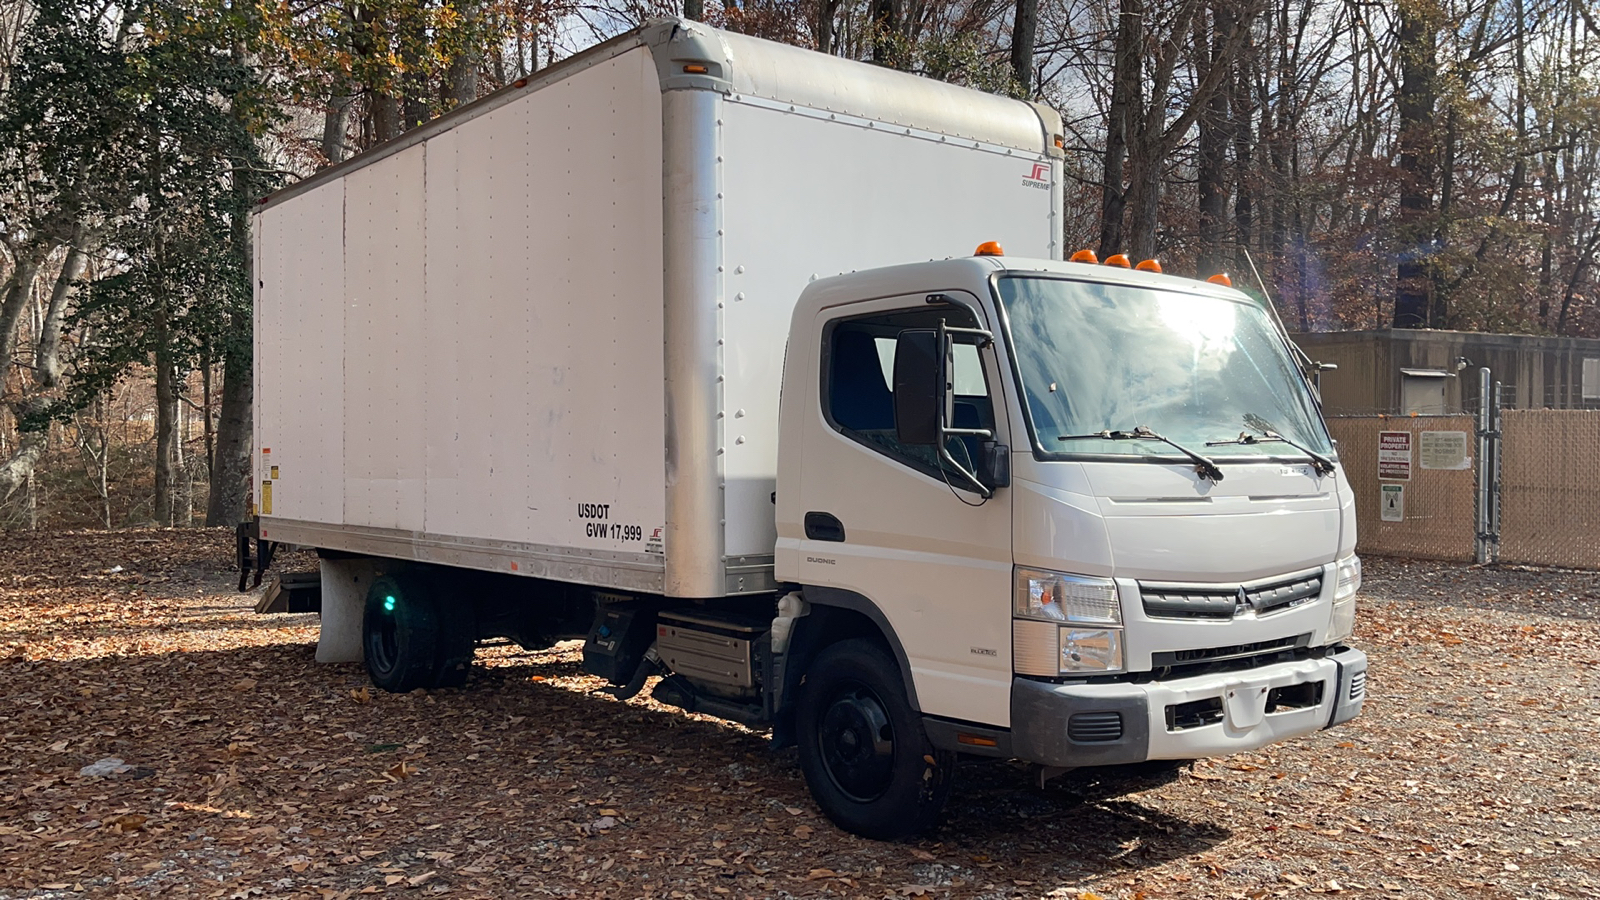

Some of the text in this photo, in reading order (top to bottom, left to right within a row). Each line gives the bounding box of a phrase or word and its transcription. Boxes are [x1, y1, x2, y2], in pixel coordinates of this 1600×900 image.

[1021, 179, 1050, 190] SUPREME
[578, 503, 610, 519] USDOT
[586, 522, 642, 543] GVW 17,999
[806, 556, 836, 565] DUONIC
